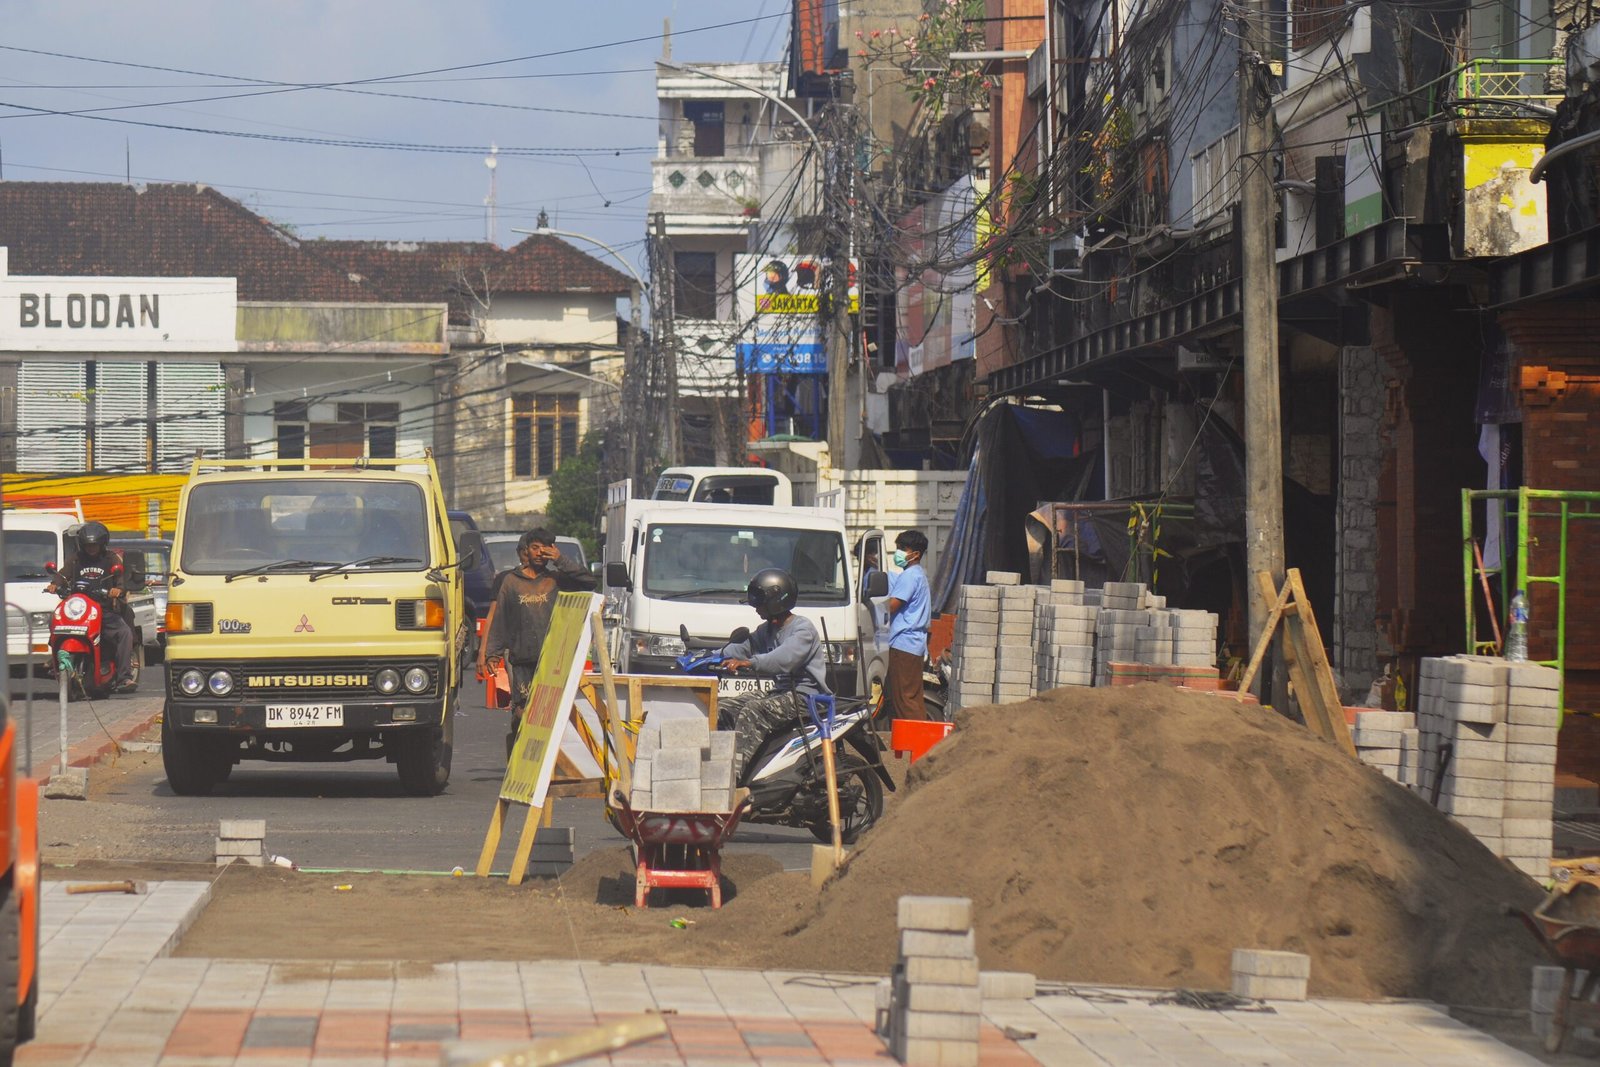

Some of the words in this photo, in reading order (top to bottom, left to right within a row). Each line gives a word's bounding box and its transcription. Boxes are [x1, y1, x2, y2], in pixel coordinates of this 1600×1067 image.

[772, 297, 815, 309] JAKARTA
[19, 292, 160, 328] BLODAN
[248, 675, 368, 687] MITSUBISHI
[268, 707, 283, 720] DK
[289, 707, 319, 720] 8942
[326, 706, 341, 719] FM
